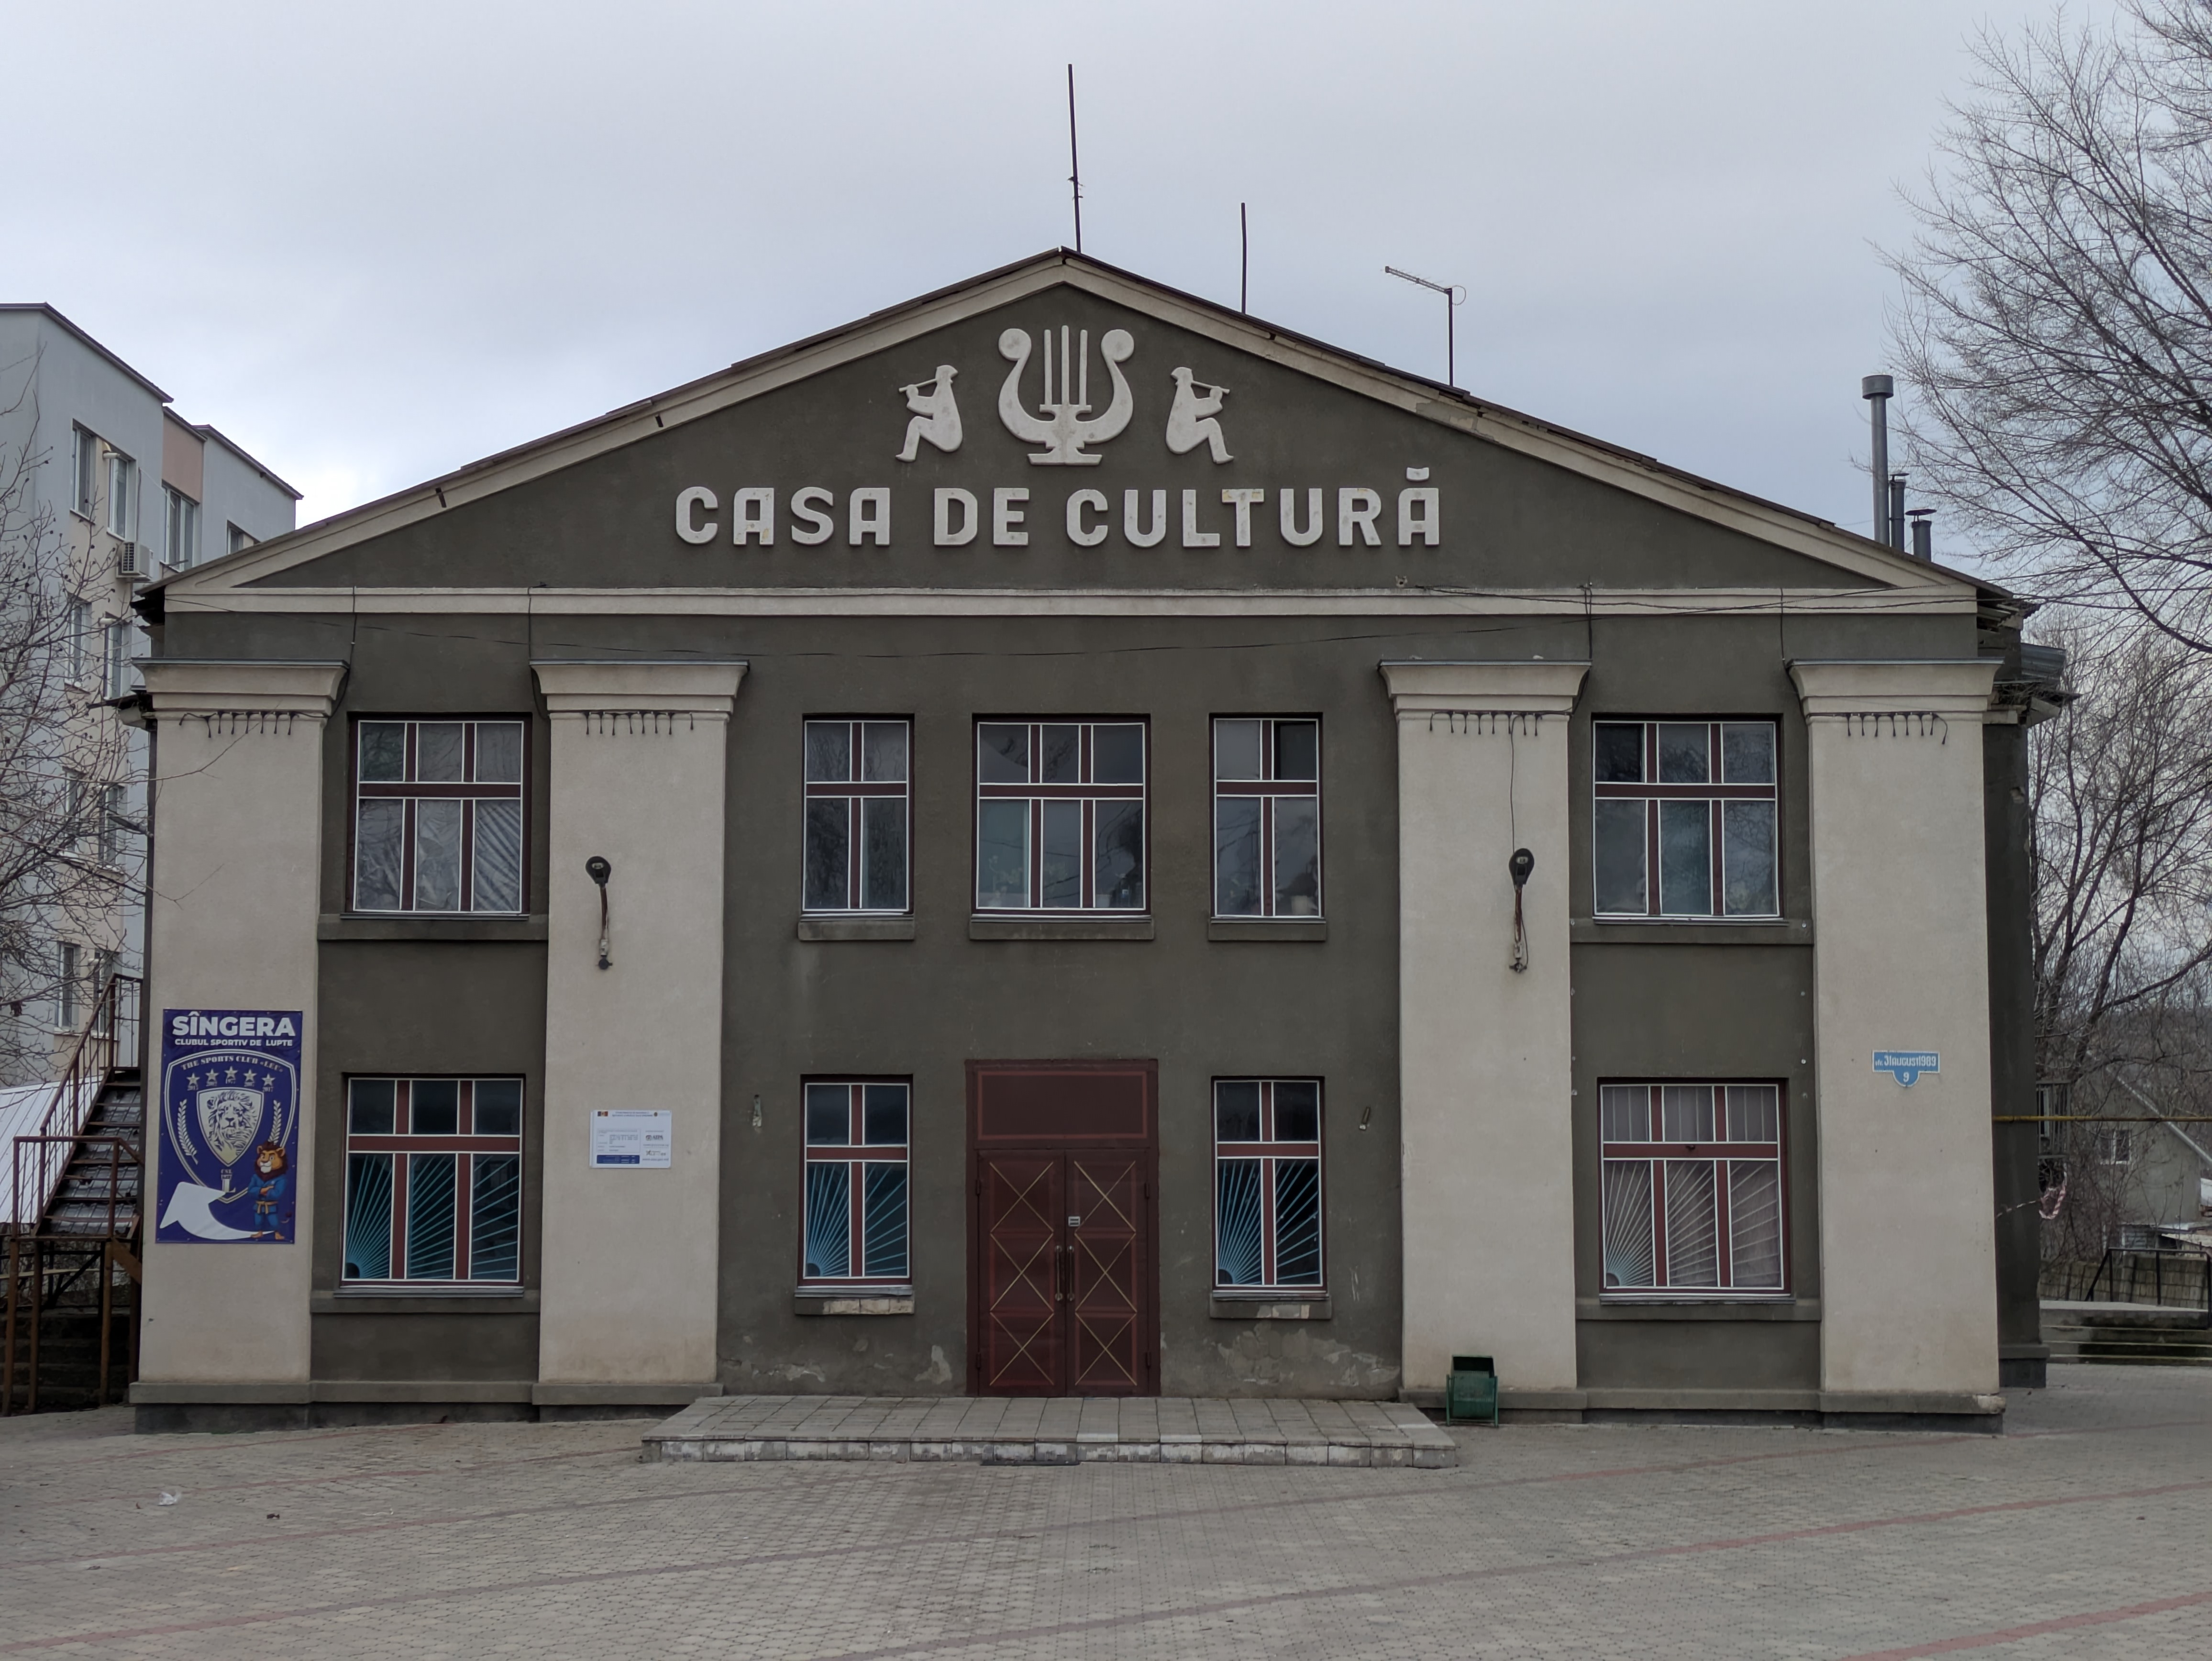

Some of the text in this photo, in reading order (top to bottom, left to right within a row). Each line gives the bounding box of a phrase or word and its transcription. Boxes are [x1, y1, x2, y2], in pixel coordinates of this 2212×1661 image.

[675, 467, 1440, 547] CASA DE CULTURĂ
[172, 1011, 296, 1036] SÎNGERA
[181, 1060, 199, 1070] THE
[201, 1055, 234, 1065] SPORTS
[236, 1056, 258, 1064] CLUB
[1903, 1072, 1910, 1083] 9
